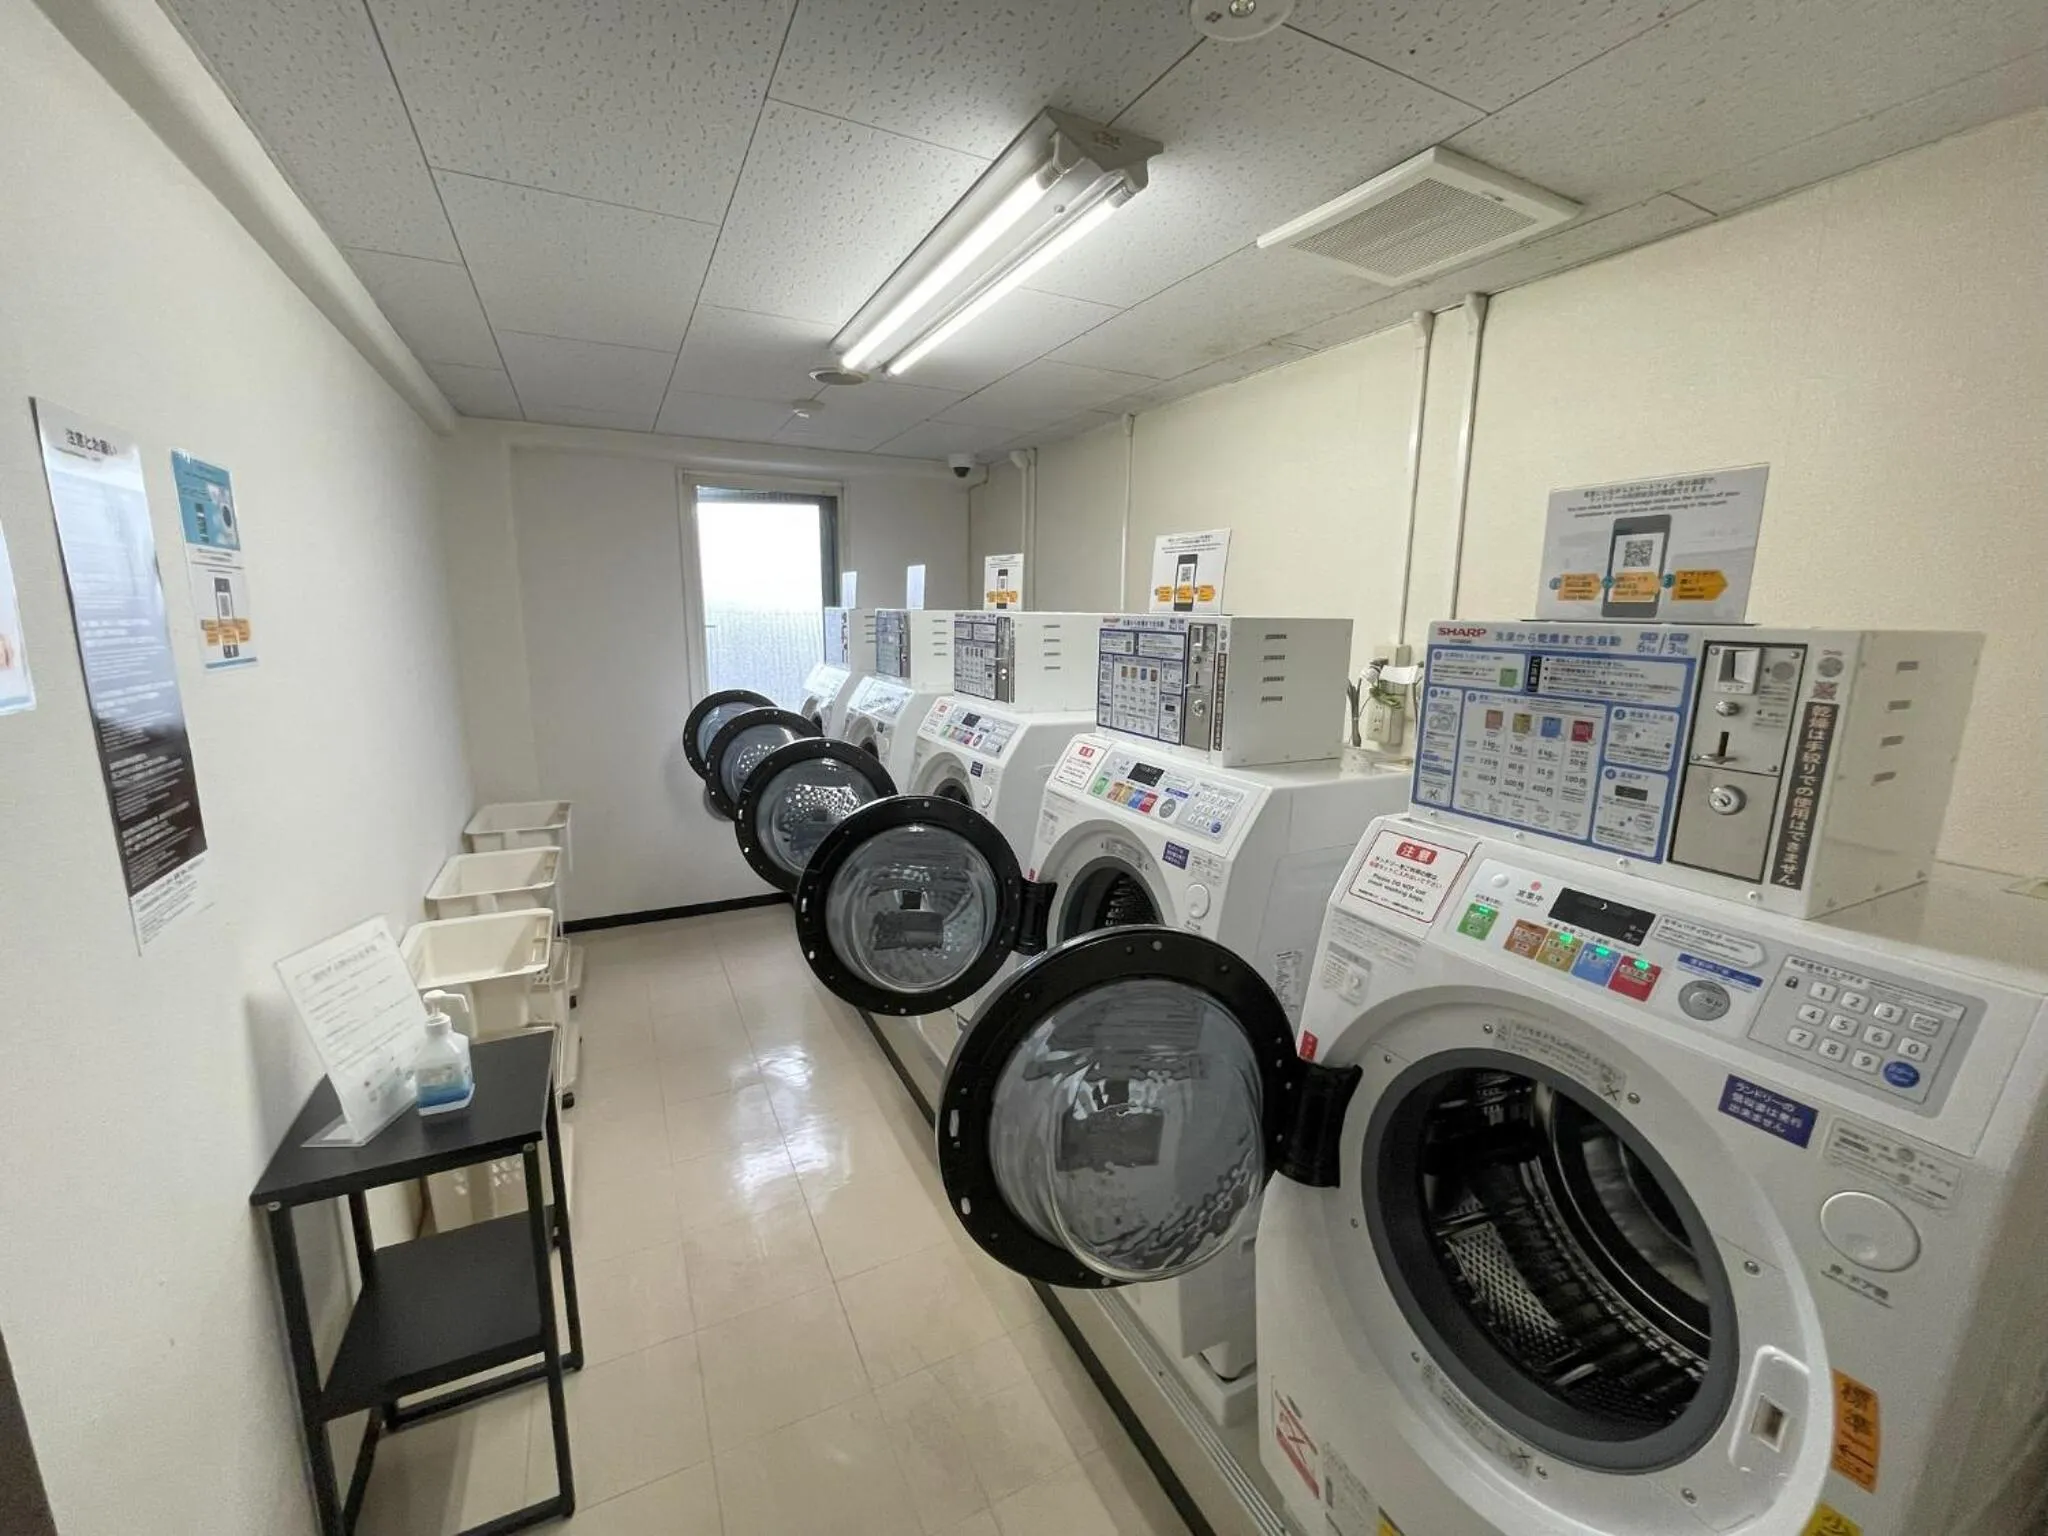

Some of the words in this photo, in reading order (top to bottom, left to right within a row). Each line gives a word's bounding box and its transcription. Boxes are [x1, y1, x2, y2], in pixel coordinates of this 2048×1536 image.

[1437, 628, 1487, 638] SHARP
[1399, 844, 1432, 864] 注意
[1819, 987, 1827, 996] 1
[1850, 997, 1861, 1008] 2
[1806, 1010, 1816, 1019] 4
[1883, 1007, 1894, 1018] 3
[1838, 1020, 1848, 1031] 5
[1796, 1033, 1807, 1042] 7
[1872, 1032, 1883, 1042] 6
[1827, 1044, 1838, 1055] 8
[1907, 1043, 1919, 1055] 0
[1861, 1056, 1872, 1067] 9
[1735, 1082, 1795, 1112] ランドリーの
